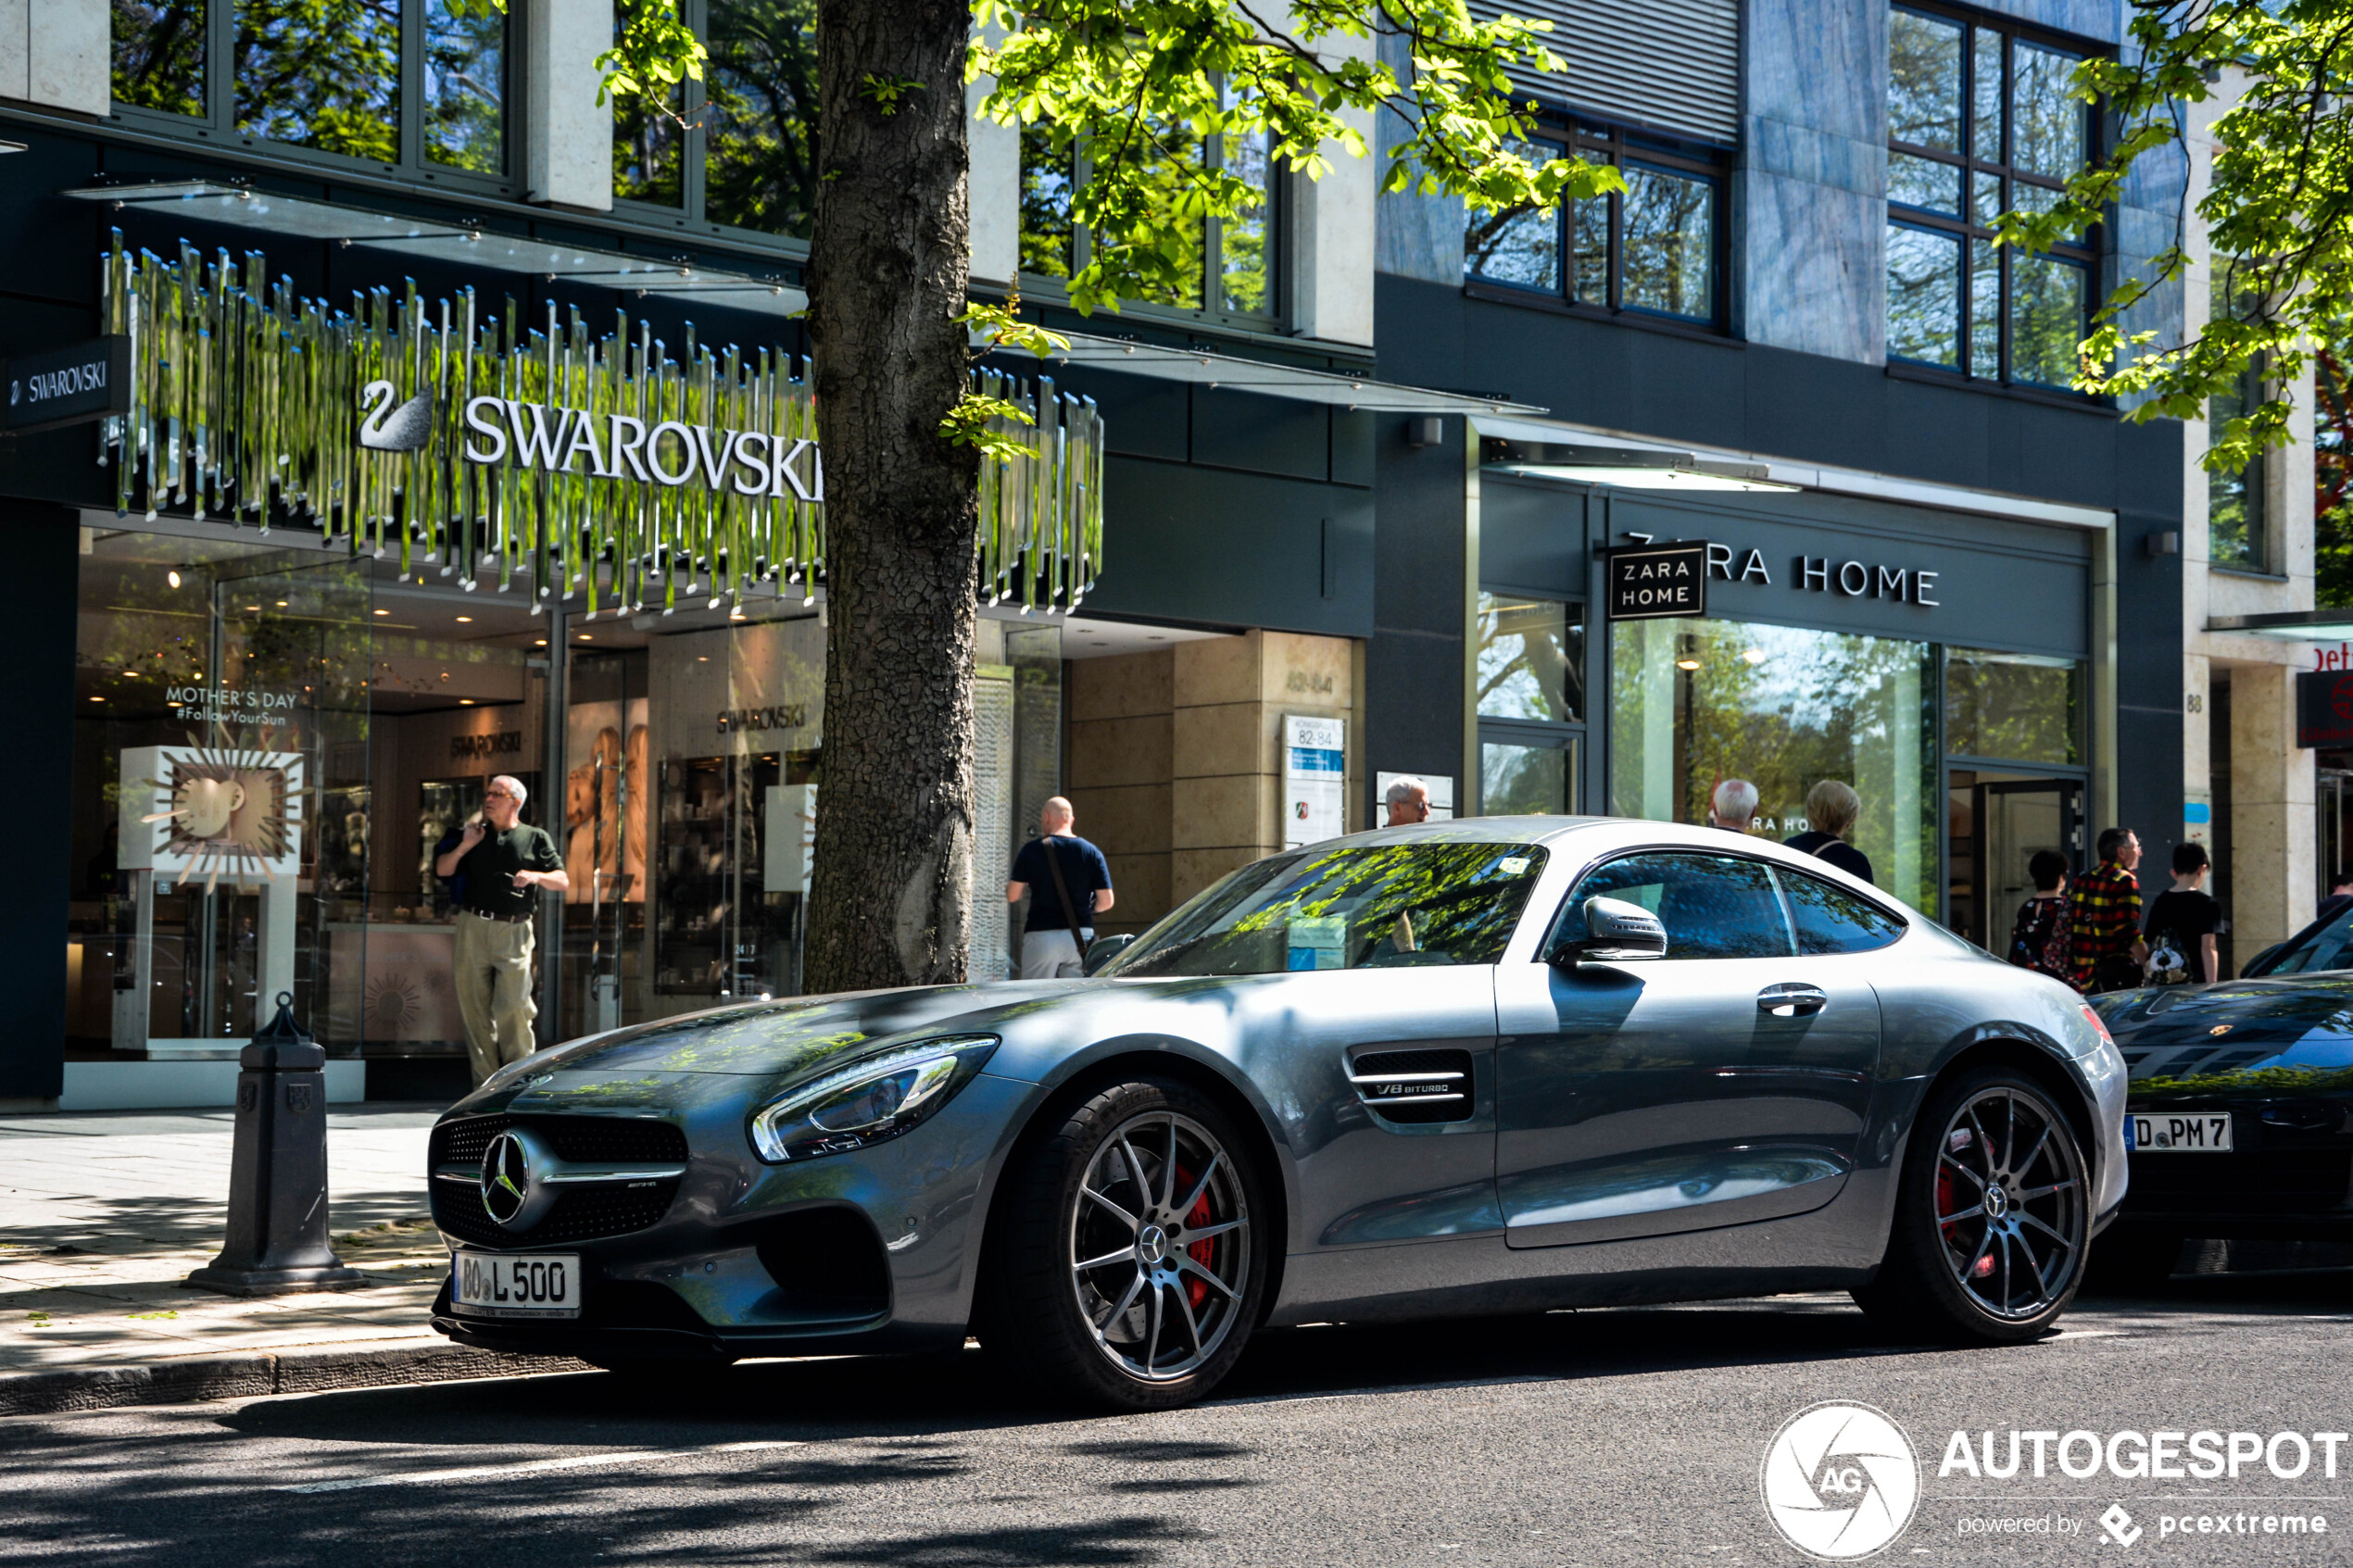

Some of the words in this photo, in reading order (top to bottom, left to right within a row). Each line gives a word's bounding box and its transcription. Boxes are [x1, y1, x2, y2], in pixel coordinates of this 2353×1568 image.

[29, 360, 107, 403] SWAROVSKI
[465, 395, 824, 502] SWAROVSKI
[1623, 560, 1690, 581] ZARA
[1629, 532, 1771, 584] RA
[1804, 555, 1940, 607] HOME
[1622, 586, 1689, 606] HOME
[165, 686, 258, 708] MOTHER'S
[262, 692, 297, 709] DAY
[2187, 694, 2203, 713] 88
[176, 707, 286, 726] #FollowYourSun
[1298, 729, 1332, 746] 82-84
[1377, 1084, 1403, 1096] V8
[1403, 1084, 1449, 1094] BITURBO
[2135, 1119, 2152, 1147] D
[463, 1259, 481, 1299] BO
